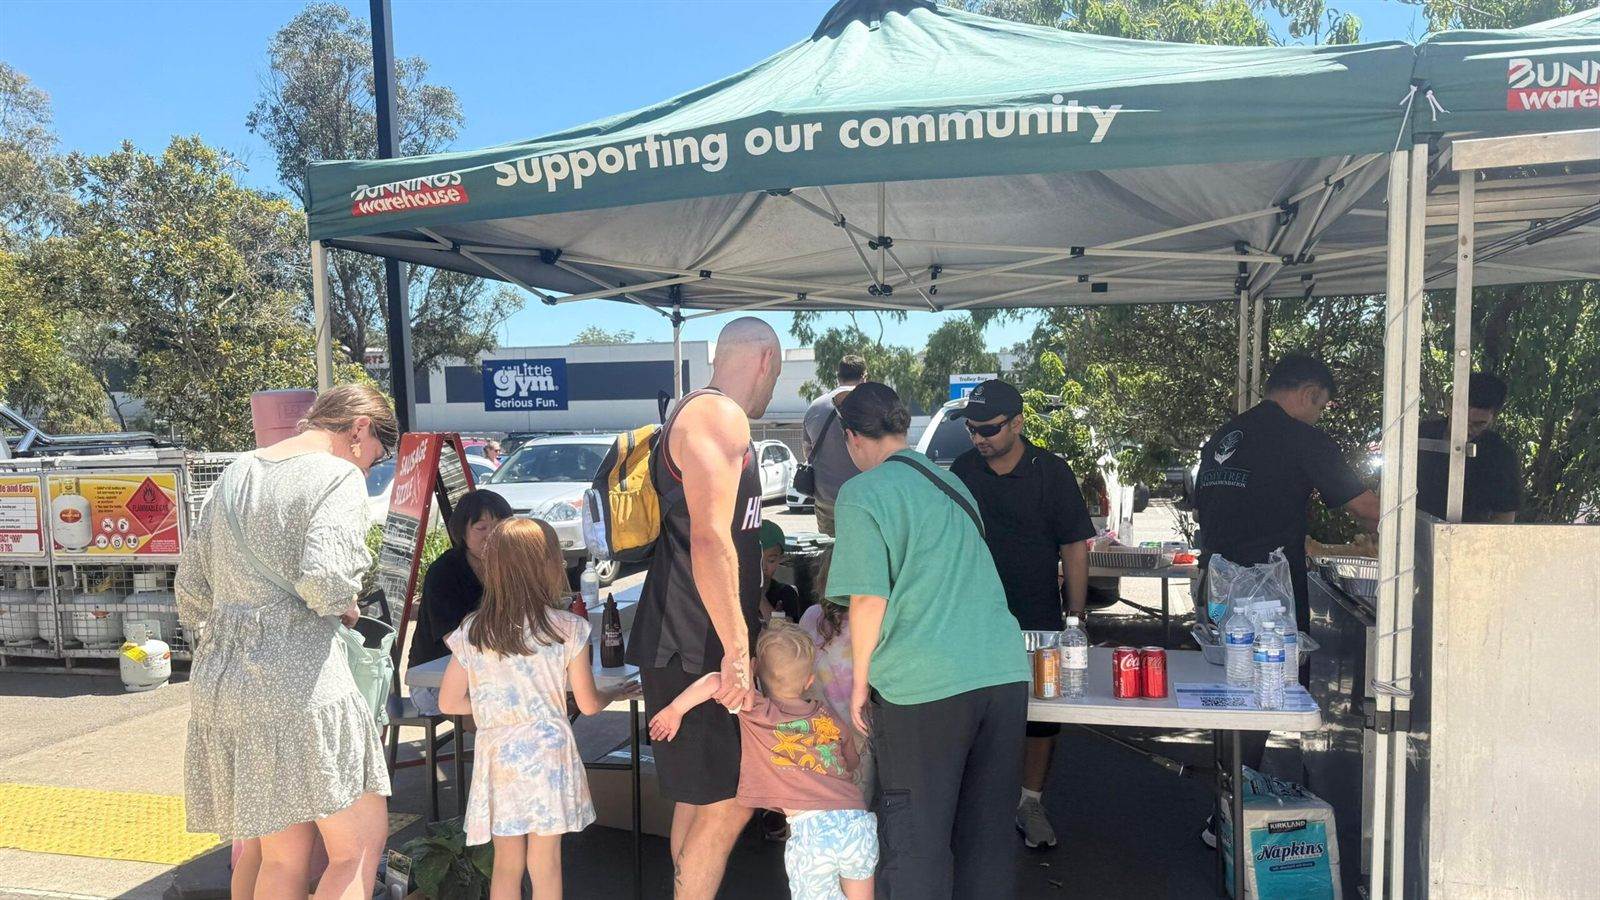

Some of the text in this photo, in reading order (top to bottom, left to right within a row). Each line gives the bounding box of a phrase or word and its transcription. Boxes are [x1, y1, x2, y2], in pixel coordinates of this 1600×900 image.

[1519, 88, 1600, 110] ware
[744, 120, 823, 156] our
[838, 93, 1123, 148] community
[359, 187, 461, 214] warehouse
[516, 362, 553, 376] Little
[494, 398, 558, 408] Serious Fun.
[19, 484, 33, 493] Easy
[1270, 821, 1306, 831] KIRKLAND
[1256, 841, 1324, 861] Napkins
